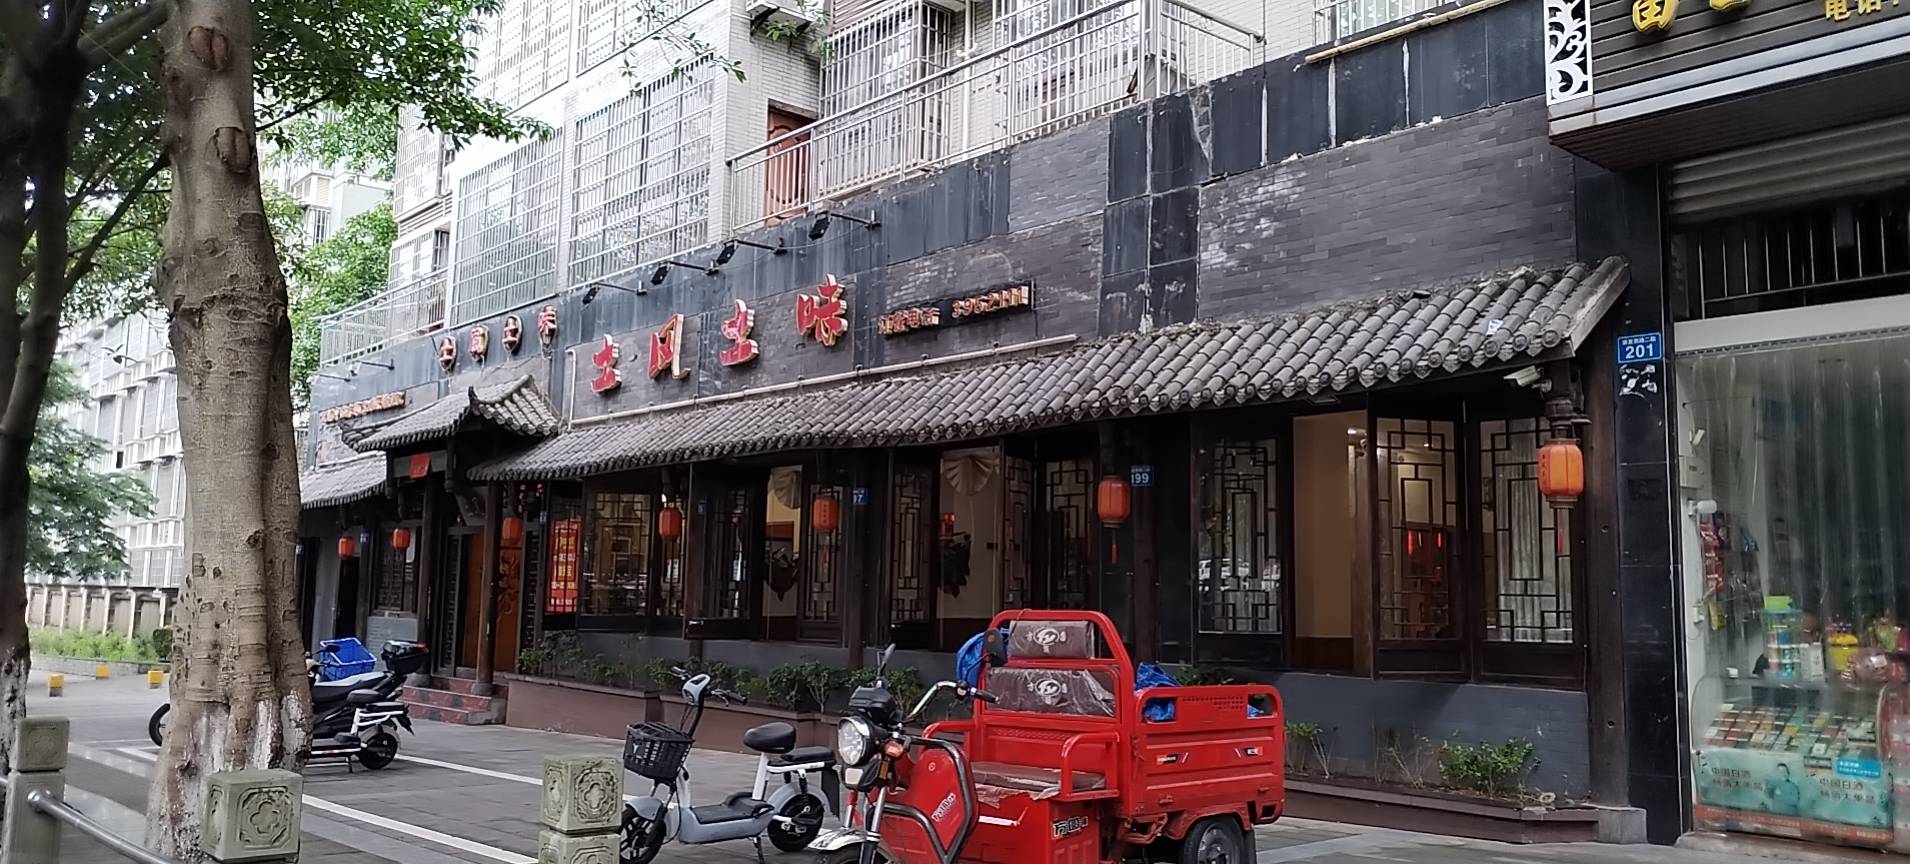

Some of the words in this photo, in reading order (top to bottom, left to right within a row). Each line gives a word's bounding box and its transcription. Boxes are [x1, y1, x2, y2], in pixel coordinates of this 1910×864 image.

[590, 273, 849, 393] 土风土味
[1625, 343, 1654, 359] 201
[1131, 472, 1149, 484] 199
